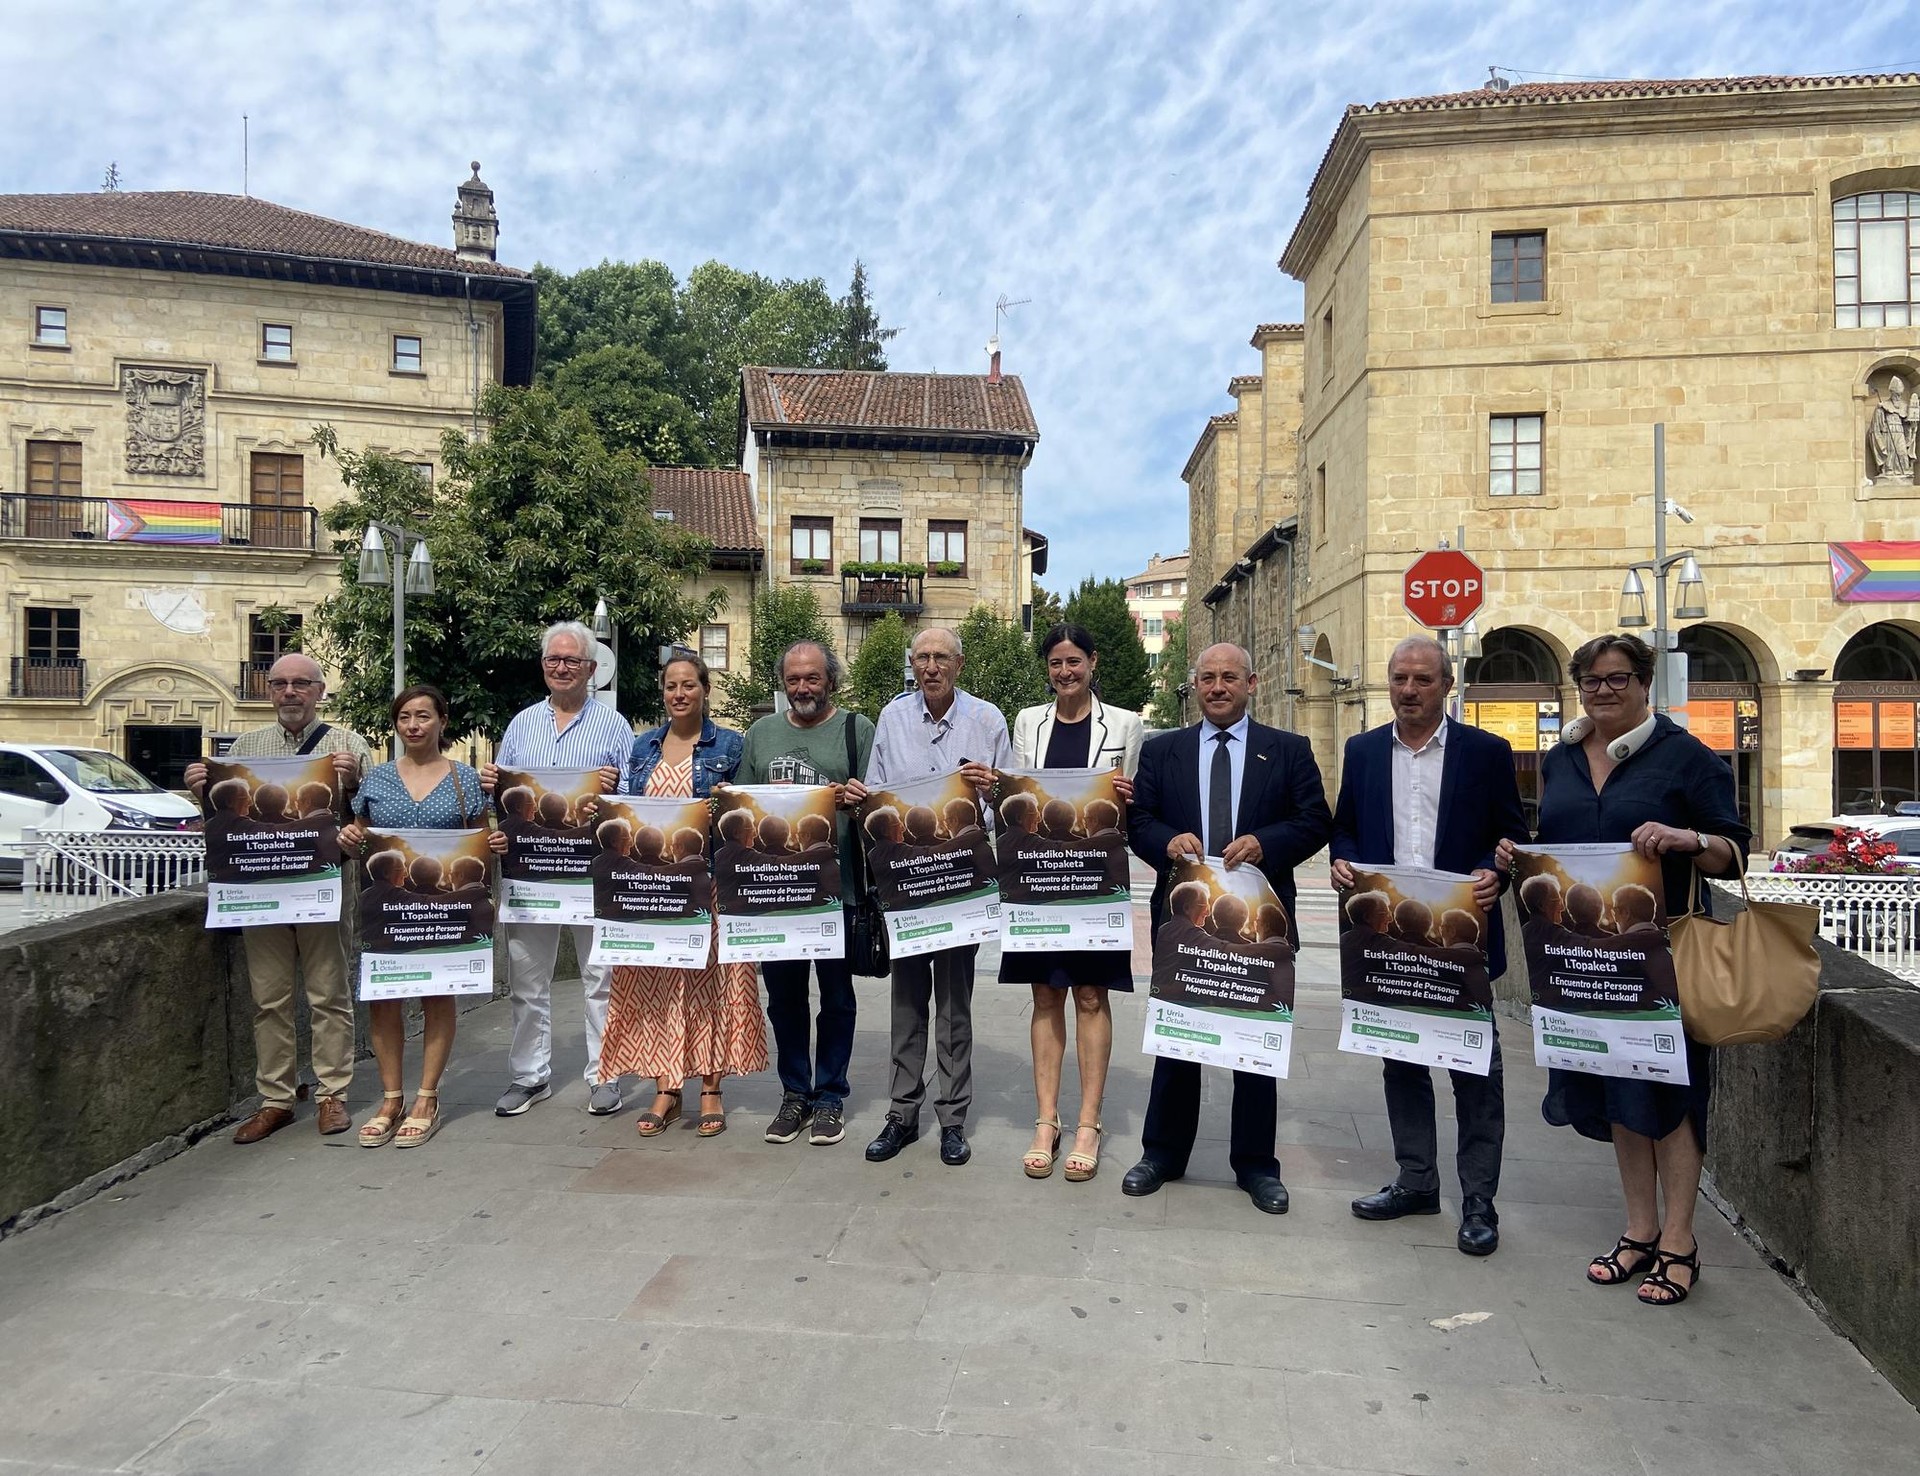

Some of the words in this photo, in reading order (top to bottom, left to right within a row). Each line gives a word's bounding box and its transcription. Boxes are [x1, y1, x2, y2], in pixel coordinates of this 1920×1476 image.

[1409, 579, 1478, 598] STOP
[227, 832, 274, 841] Euskadiko
[276, 830, 319, 839] Nagusien
[517, 836, 557, 844] Euskadiko
[890, 855, 932, 869] Euskadiko
[934, 848, 973, 861] Nagusien
[1018, 850, 1064, 859] Euskadiko
[1066, 849, 1107, 859] Nagusien
[235, 856, 270, 864] Encuentro
[241, 864, 270, 872] Mayores
[735, 864, 778, 872] Euskadiko
[780, 863, 820, 872] Nagusien
[612, 872, 652, 881] Euskadiko
[654, 873, 692, 882] Nagusien
[903, 879, 934, 890] Encuentro
[945, 872, 973, 883] Personas
[509, 886, 515, 896] 1
[909, 886, 936, 897] Mayores
[946, 880, 971, 890] Euskadi
[1071, 883, 1098, 891] Euskadi
[217, 890, 225, 901] 1
[383, 903, 428, 911] Euskadiko
[431, 902, 471, 912] Nagusien
[1009, 911, 1016, 922] 1
[727, 922, 734, 933] 1
[894, 918, 902, 929] 1
[601, 927, 607, 937] 1
[1178, 944, 1228, 960] Euskadiko
[1230, 952, 1275, 968] Nagusien
[1545, 944, 1592, 957] Euskadiko
[1594, 948, 1645, 961] Nagusien
[371, 960, 378, 971] 1
[1364, 949, 1417, 962] Euskadiko
[1420, 954, 1465, 973] Nagusien
[1181, 974, 1219, 987] Encuentro
[1231, 982, 1265, 994] Personas
[1372, 976, 1411, 988] Encuentro
[1424, 982, 1460, 995] Personas
[1556, 977, 1590, 988] Encuentro
[1592, 980, 1602, 989] de
[1604, 982, 1642, 991] Personas
[1185, 984, 1217, 996] Mayores
[1218, 990, 1228, 998] de
[1229, 992, 1259, 1003] Euskadi
[1378, 986, 1410, 996] Mayores
[1412, 990, 1422, 998] de
[1424, 991, 1454, 1003] Euskadi
[1562, 988, 1591, 999] Mayores
[1593, 991, 1603, 1000] de
[1605, 992, 1638, 1002] Euskadi
[1156, 1008, 1164, 1021] 1
[1352, 1008, 1360, 1020] 1
[1541, 1016, 1549, 1030] 1
